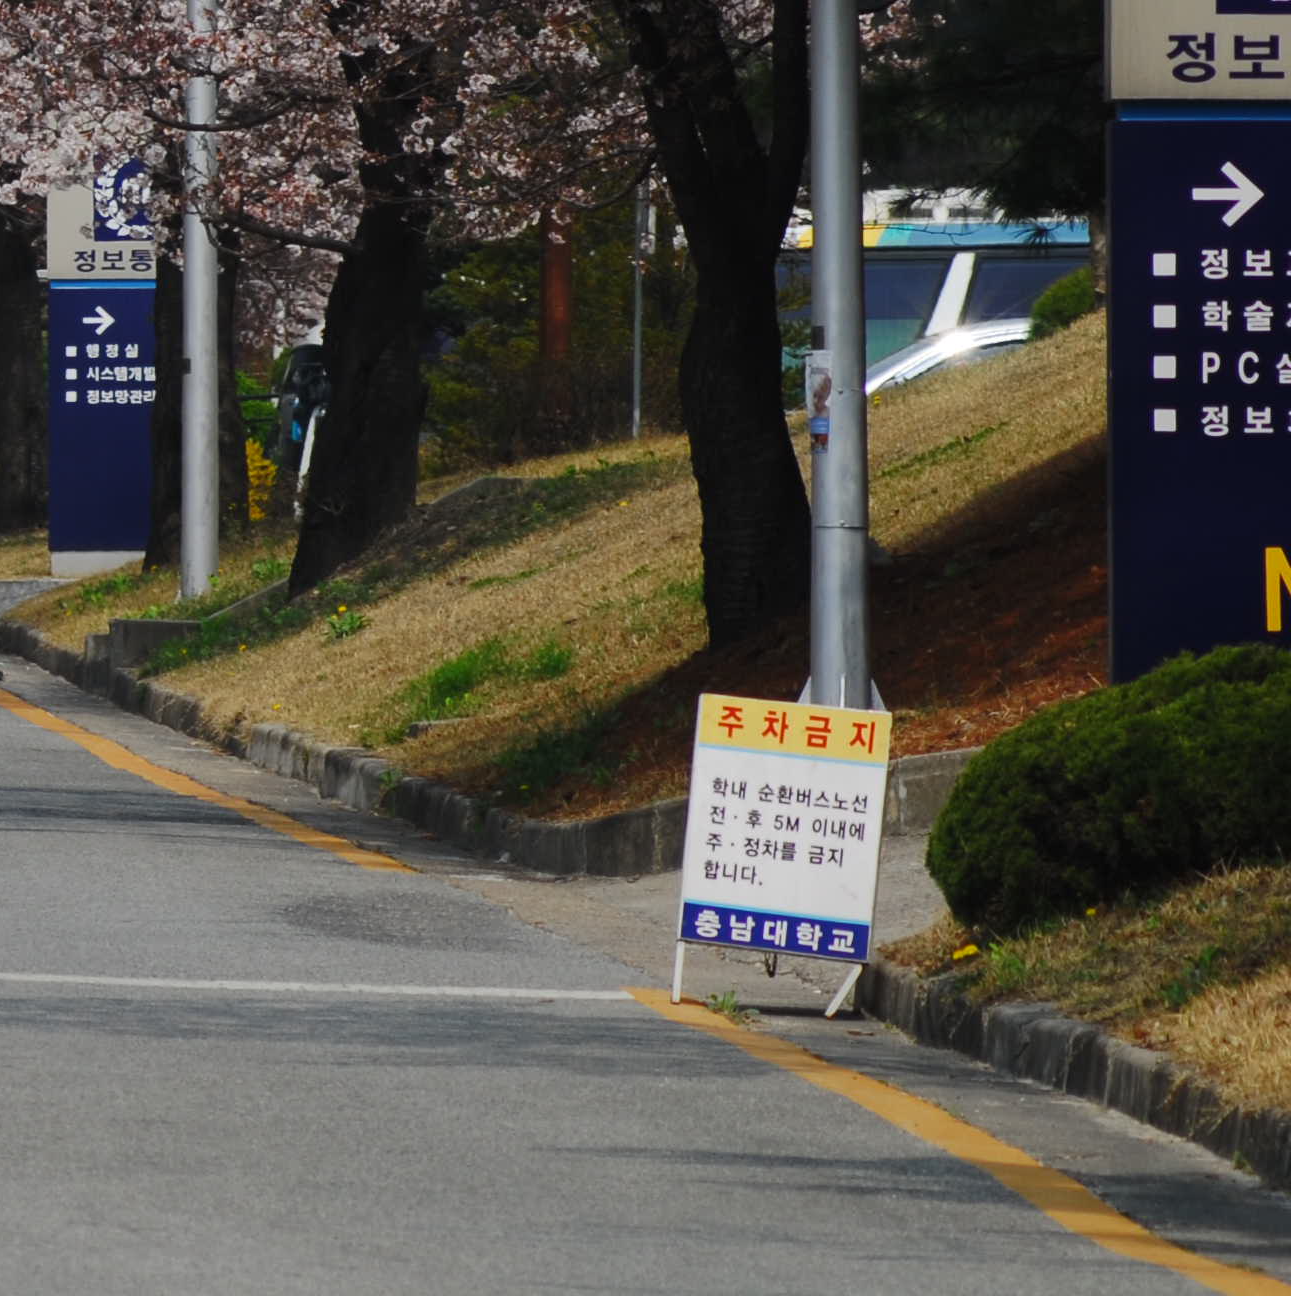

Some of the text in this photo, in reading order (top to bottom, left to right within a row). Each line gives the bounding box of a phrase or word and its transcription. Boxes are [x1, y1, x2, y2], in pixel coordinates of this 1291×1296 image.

[1166, 32, 1286, 83] 정보
[74, 249, 154, 273] 정보통
[1201, 248, 1291, 279] 정보
[1201, 300, 1291, 332] 학술
[1201, 405, 1291, 437] 정보
[717, 705, 877, 755] 주차금지
[712, 777, 868, 814] 학내 순환버스노선
[773, 814, 800, 833] 5M
[812, 818, 866, 842] 이내에
[808, 844, 845, 869] 금지
[704, 859, 763, 887] 합니다.
[694, 908, 856, 954] 충남대학교
